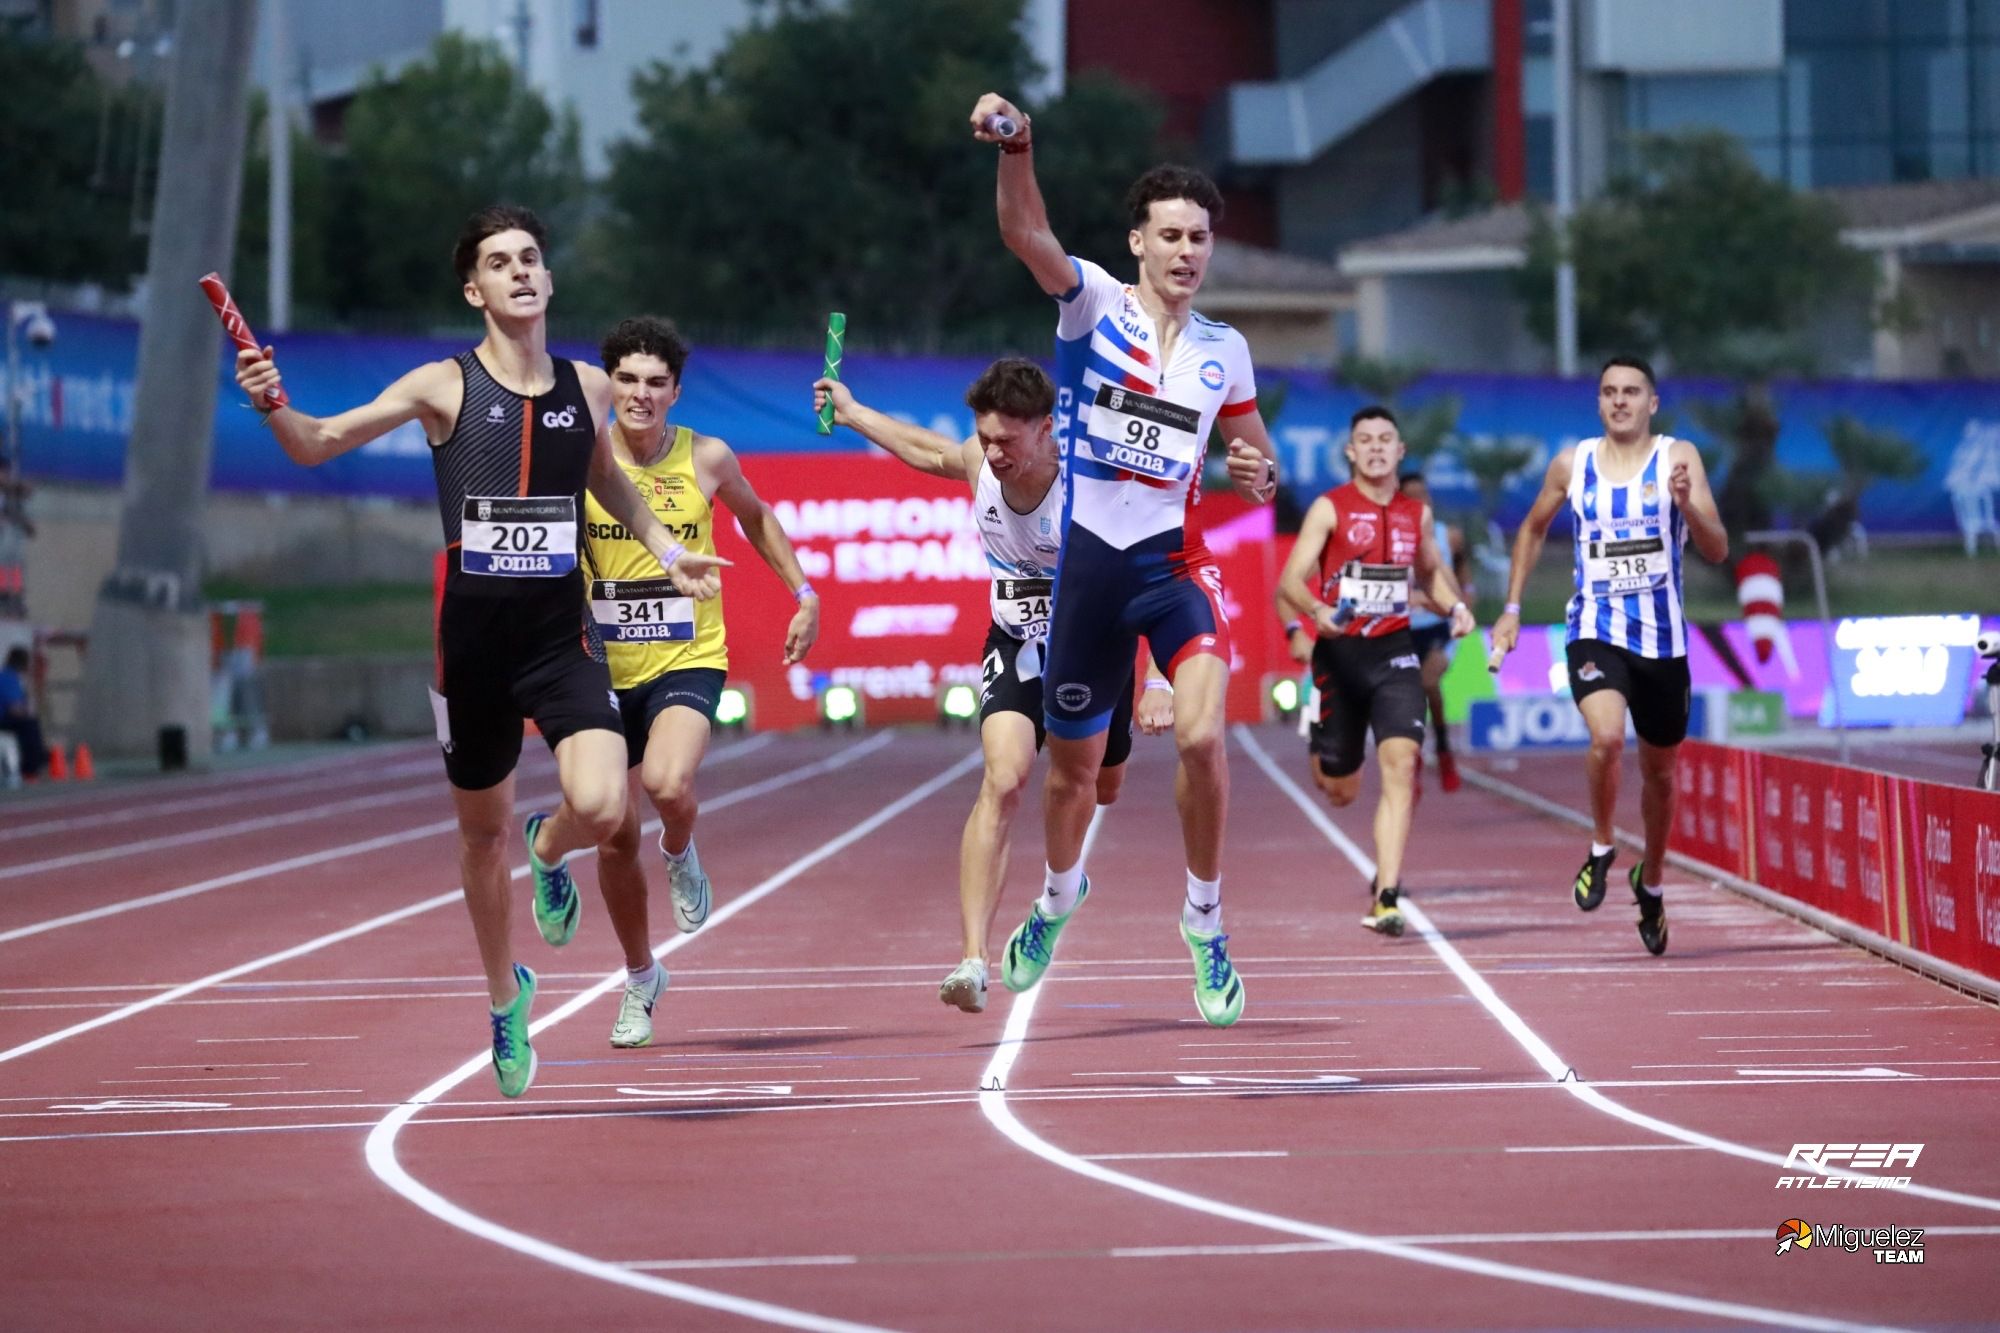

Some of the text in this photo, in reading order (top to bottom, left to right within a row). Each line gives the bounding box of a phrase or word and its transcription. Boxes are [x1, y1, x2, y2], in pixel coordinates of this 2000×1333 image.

[542, 411, 574, 428] GO
[1124, 420, 1161, 451] 98
[1106, 444, 1166, 473] Joma
[491, 526, 549, 551] 202
[587, 523, 698, 540] SCO-71
[488, 555, 552, 572] Joma
[834, 534, 993, 582] ESPAÑ
[1608, 558, 1647, 577] 318
[1362, 584, 1394, 600] 172
[618, 601, 664, 623] 341
[1017, 598, 1053, 623] 34
[617, 624, 671, 640] Joma
